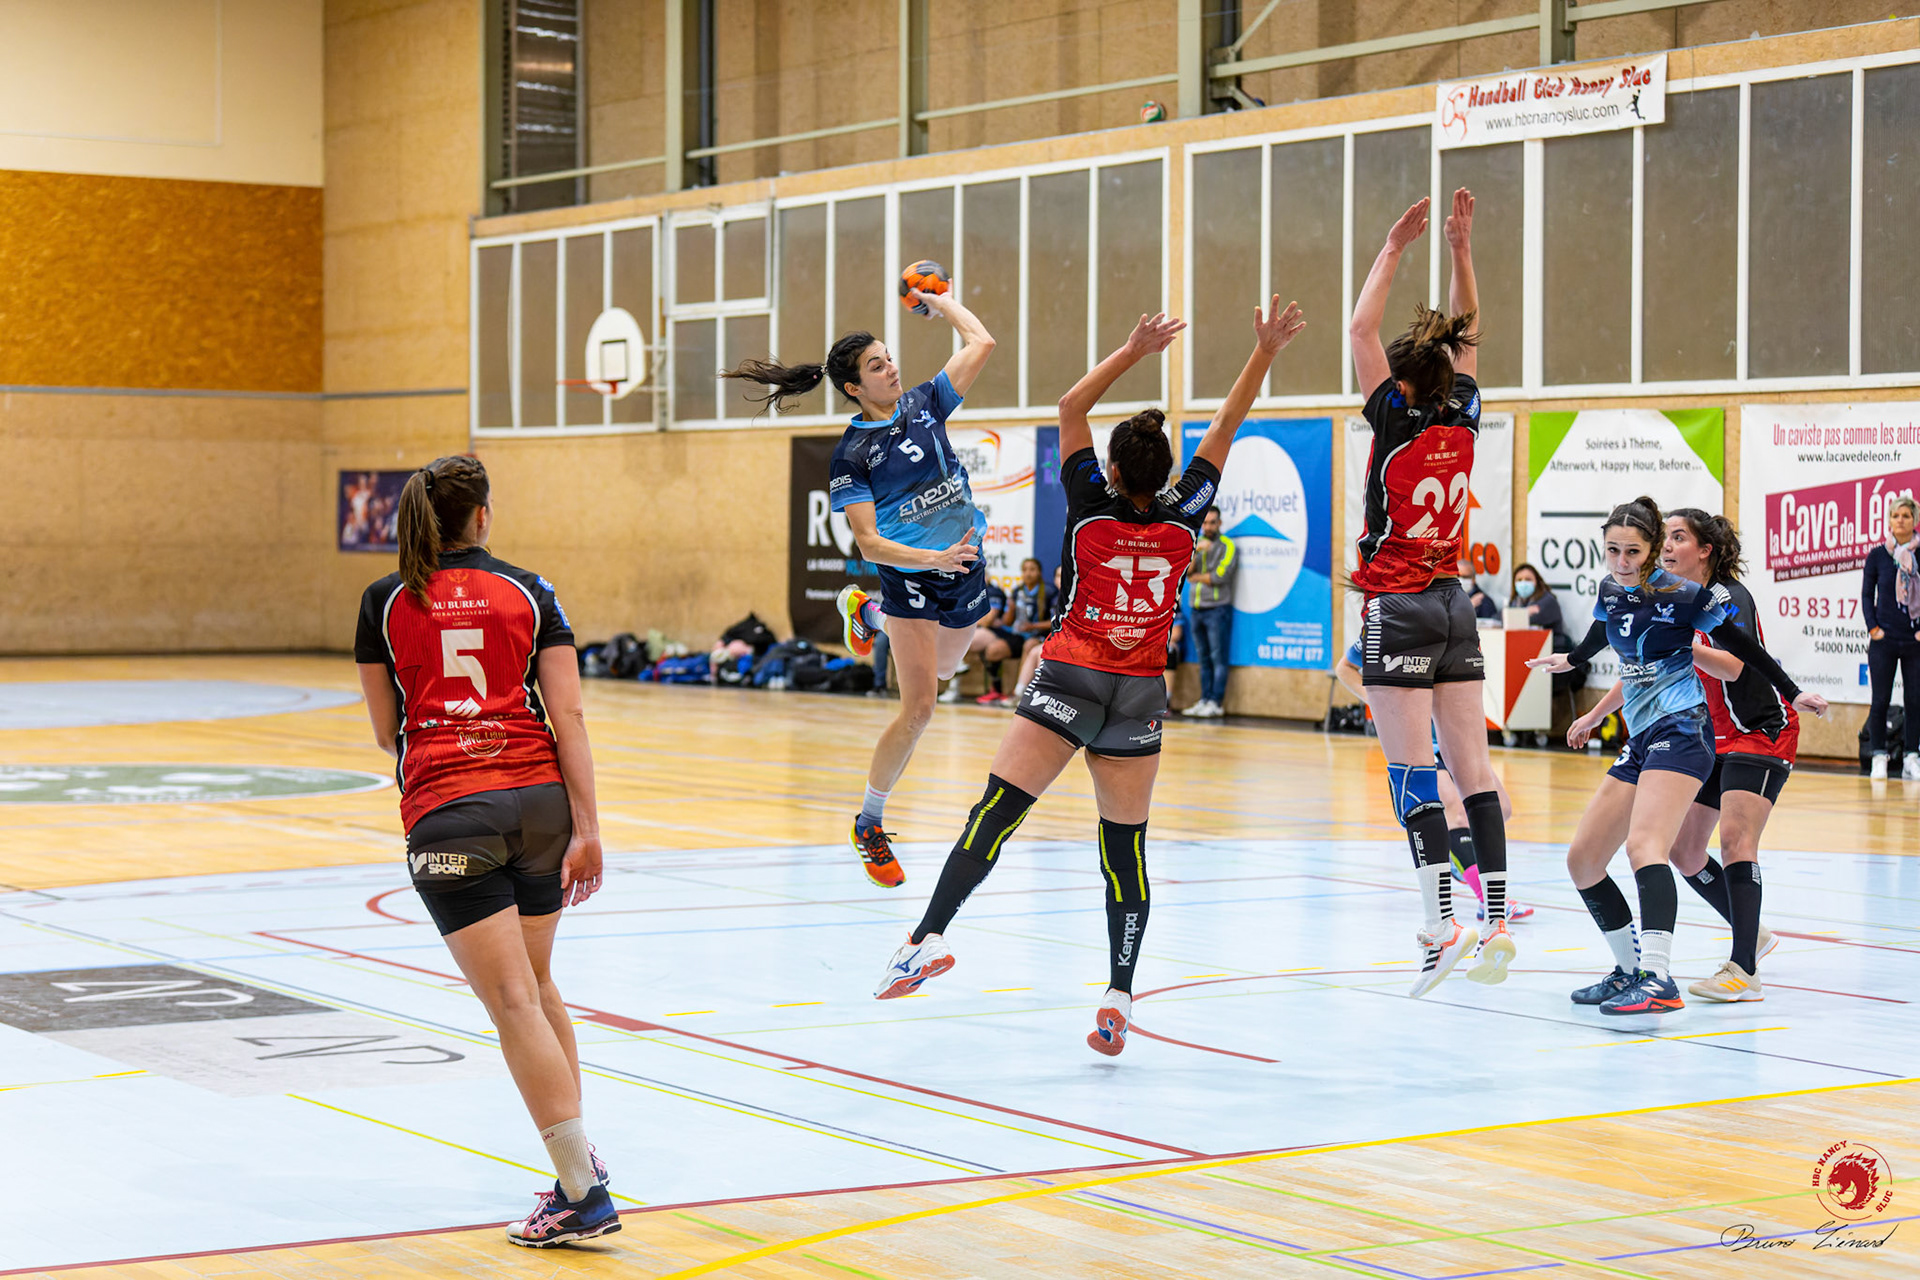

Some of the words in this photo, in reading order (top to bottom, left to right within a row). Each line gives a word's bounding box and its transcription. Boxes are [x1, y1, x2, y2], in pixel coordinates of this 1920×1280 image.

[1468, 78, 1527, 108] Handball
[1534, 75, 1566, 100] Club
[1569, 76, 1614, 98] Nancy
[1619, 65, 1651, 89] Sluc
[1485, 103, 1620, 130] www.hbcnancysluc.com
[1586, 438, 1619, 450] Soirées
[1622, 437, 1627, 449] à
[1629, 437, 1662, 450] Thème,
[1773, 423, 1786, 446] Un
[1788, 423, 1822, 446] caviste
[1824, 426, 1841, 449] pas
[1843, 426, 1878, 446] comme
[1880, 421, 1894, 445] les
[898, 438, 925, 463] 5
[1798, 450, 1901, 462] www.lacavedeleon.fr
[1550, 459, 1598, 472] Afterwork,
[1601, 461, 1630, 473] Happy
[1633, 459, 1656, 472] Hour,
[1243, 489, 1298, 516] Hoquet
[1769, 528, 1779, 557] la
[1780, 493, 1838, 555] Cave
[1840, 516, 1854, 547] de
[1855, 478, 1913, 544] Léo
[1128, 540, 1161, 549] BUREAU
[1771, 558, 1791, 568] VINS,
[1793, 546, 1852, 565] CHAMPAGNES
[1811, 564, 1821, 574] de
[1822, 563, 1836, 575] pro
[1837, 561, 1854, 573] pour
[904, 580, 926, 609] 5
[1100, 555, 1173, 613] 13
[432, 601, 446, 610] AU
[447, 599, 490, 609] BUREAU
[1779, 596, 1800, 617] 03
[1807, 597, 1830, 618] 83
[1837, 599, 1858, 619] 17
[1103, 613, 1135, 624] RAYAN
[1619, 613, 1635, 637] 3
[1802, 625, 1814, 637] 43
[1817, 627, 1833, 638] rue
[1814, 641, 1843, 655] 54000
[1846, 644, 1869, 655] NAN
[1402, 664, 1429, 674] SPORT
[1403, 655, 1431, 666] INTER
[441, 628, 488, 719] 5
[1043, 706, 1074, 724] SPORT
[1047, 697, 1078, 718] INTER
[1613, 744, 1631, 767] 3
[428, 852, 468, 865] INTER
[428, 863, 468, 876] SPORT
[1117, 912, 1140, 967] Kempa
